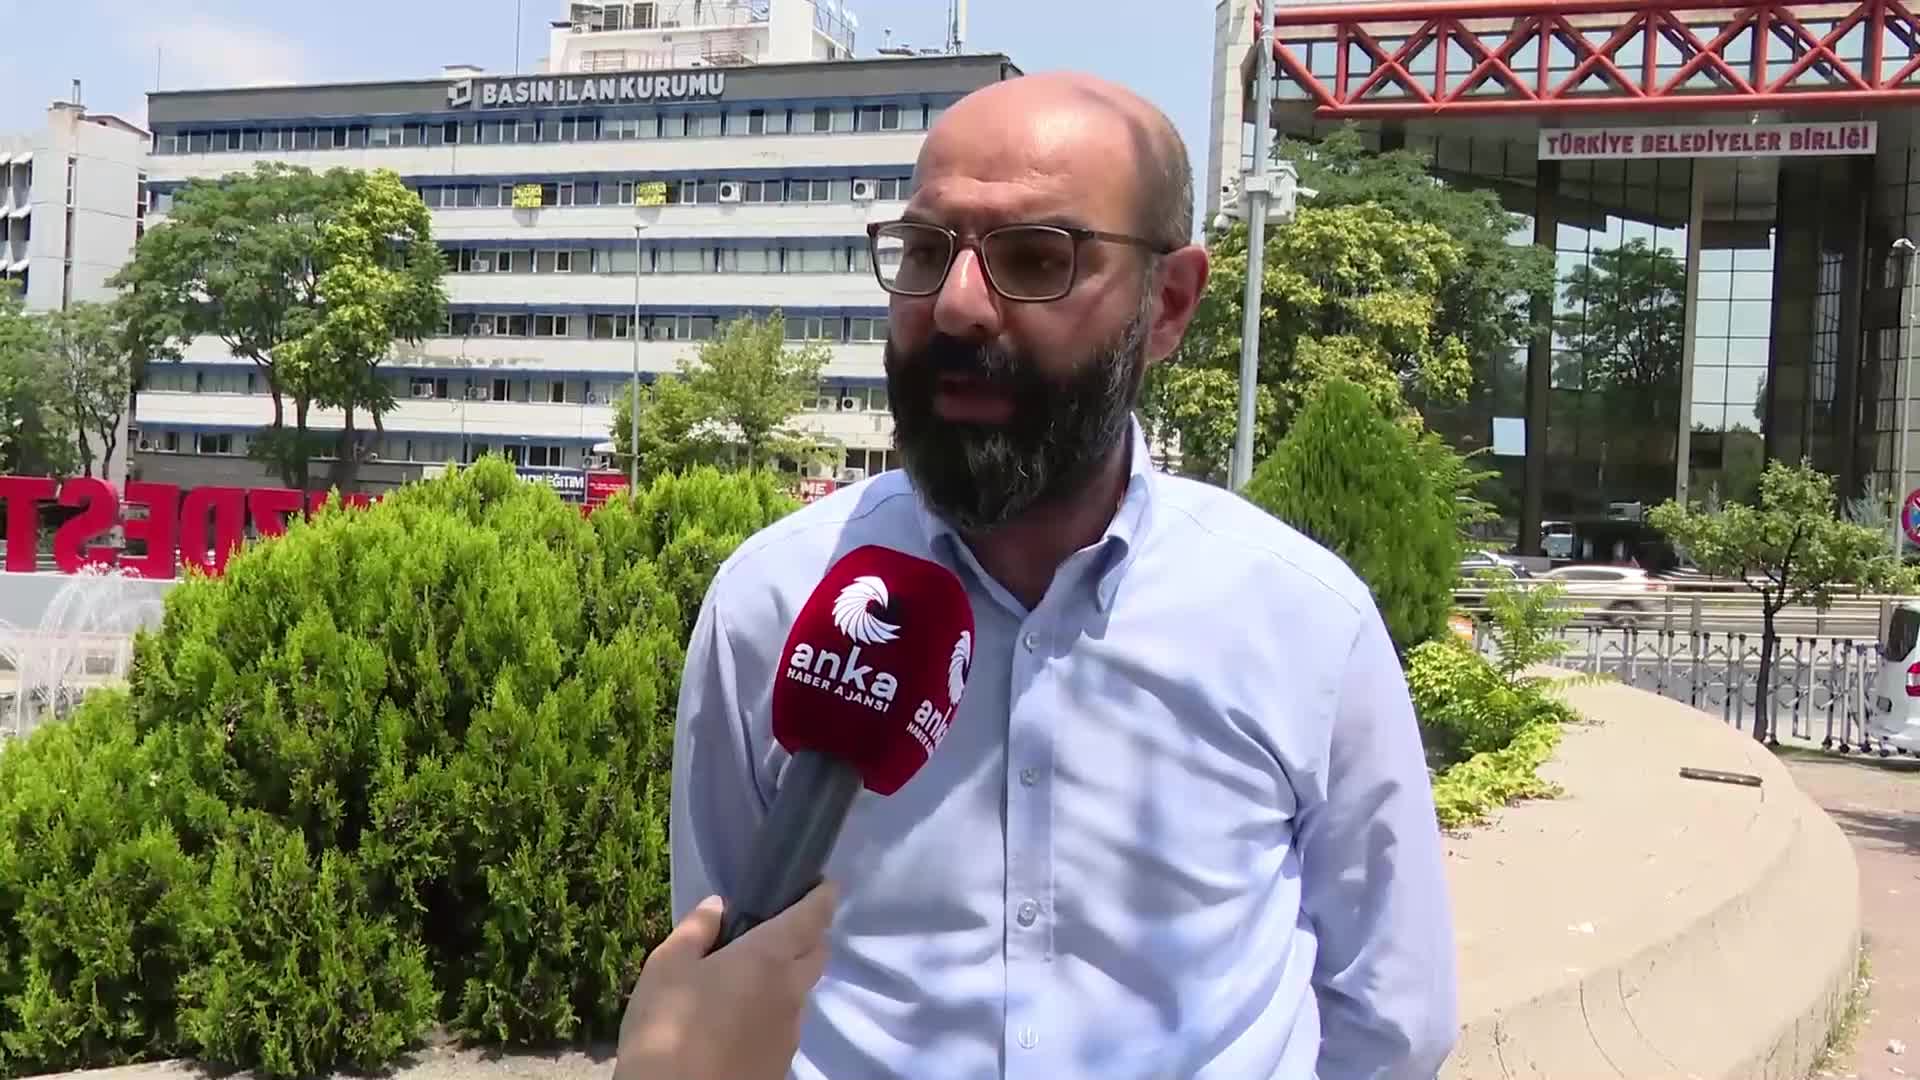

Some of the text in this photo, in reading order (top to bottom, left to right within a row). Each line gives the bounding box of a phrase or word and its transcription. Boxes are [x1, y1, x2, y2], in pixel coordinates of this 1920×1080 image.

[482, 80, 554, 104] BASIN
[619, 73, 725, 99] KURUMU
[1547, 125, 1869, 155] TÜRKİYE BELEDİYELER BİRLİĞİ
[786, 667, 890, 713] HABER AJANSI
[790, 642, 898, 702] anka
